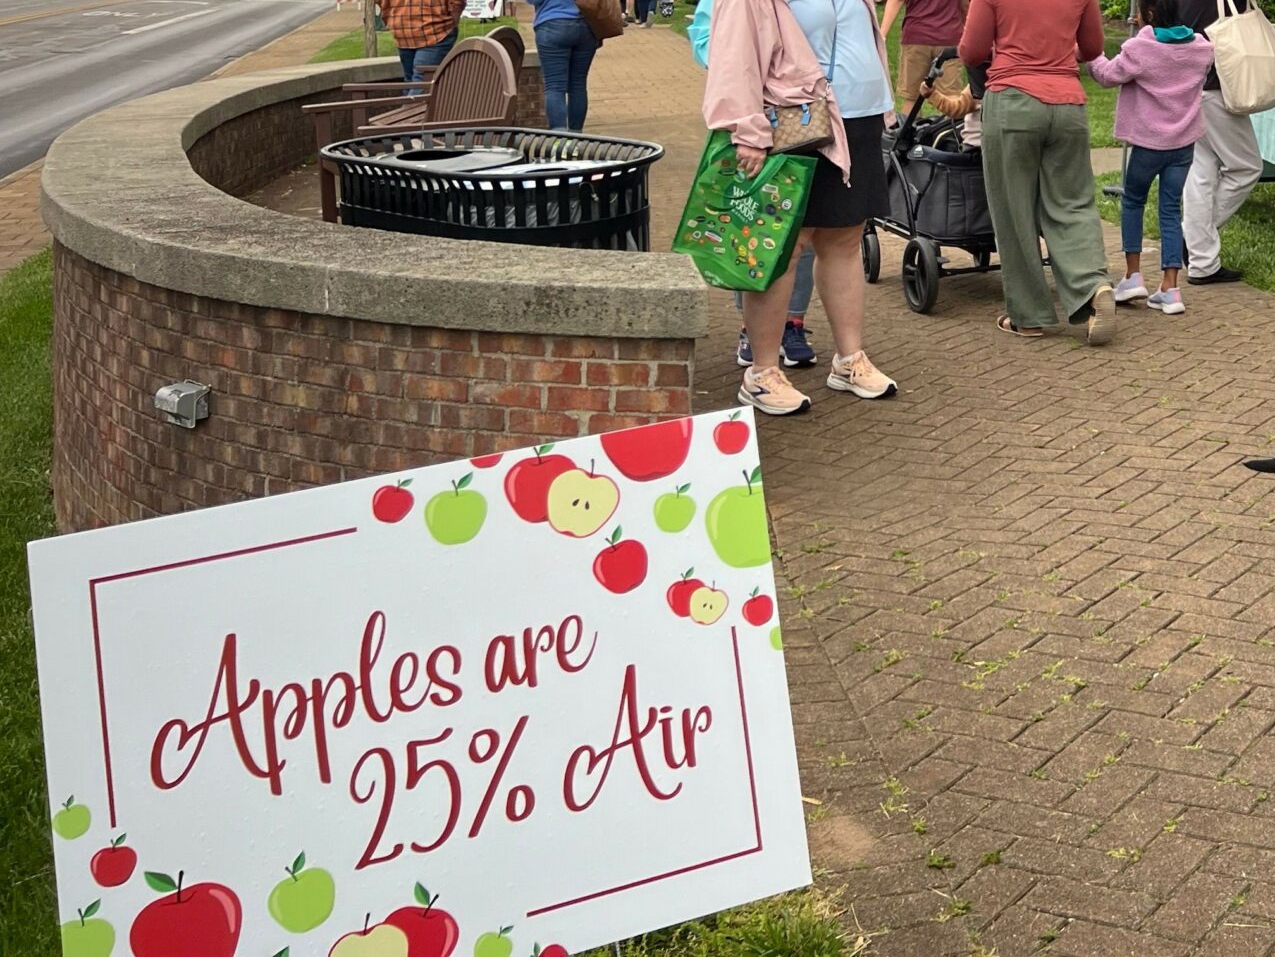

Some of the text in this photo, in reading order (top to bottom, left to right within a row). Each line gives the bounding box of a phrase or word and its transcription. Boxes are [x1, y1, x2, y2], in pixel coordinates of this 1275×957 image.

[150, 610, 599, 796] Apples are
[350, 663, 713, 871] 25% Air
